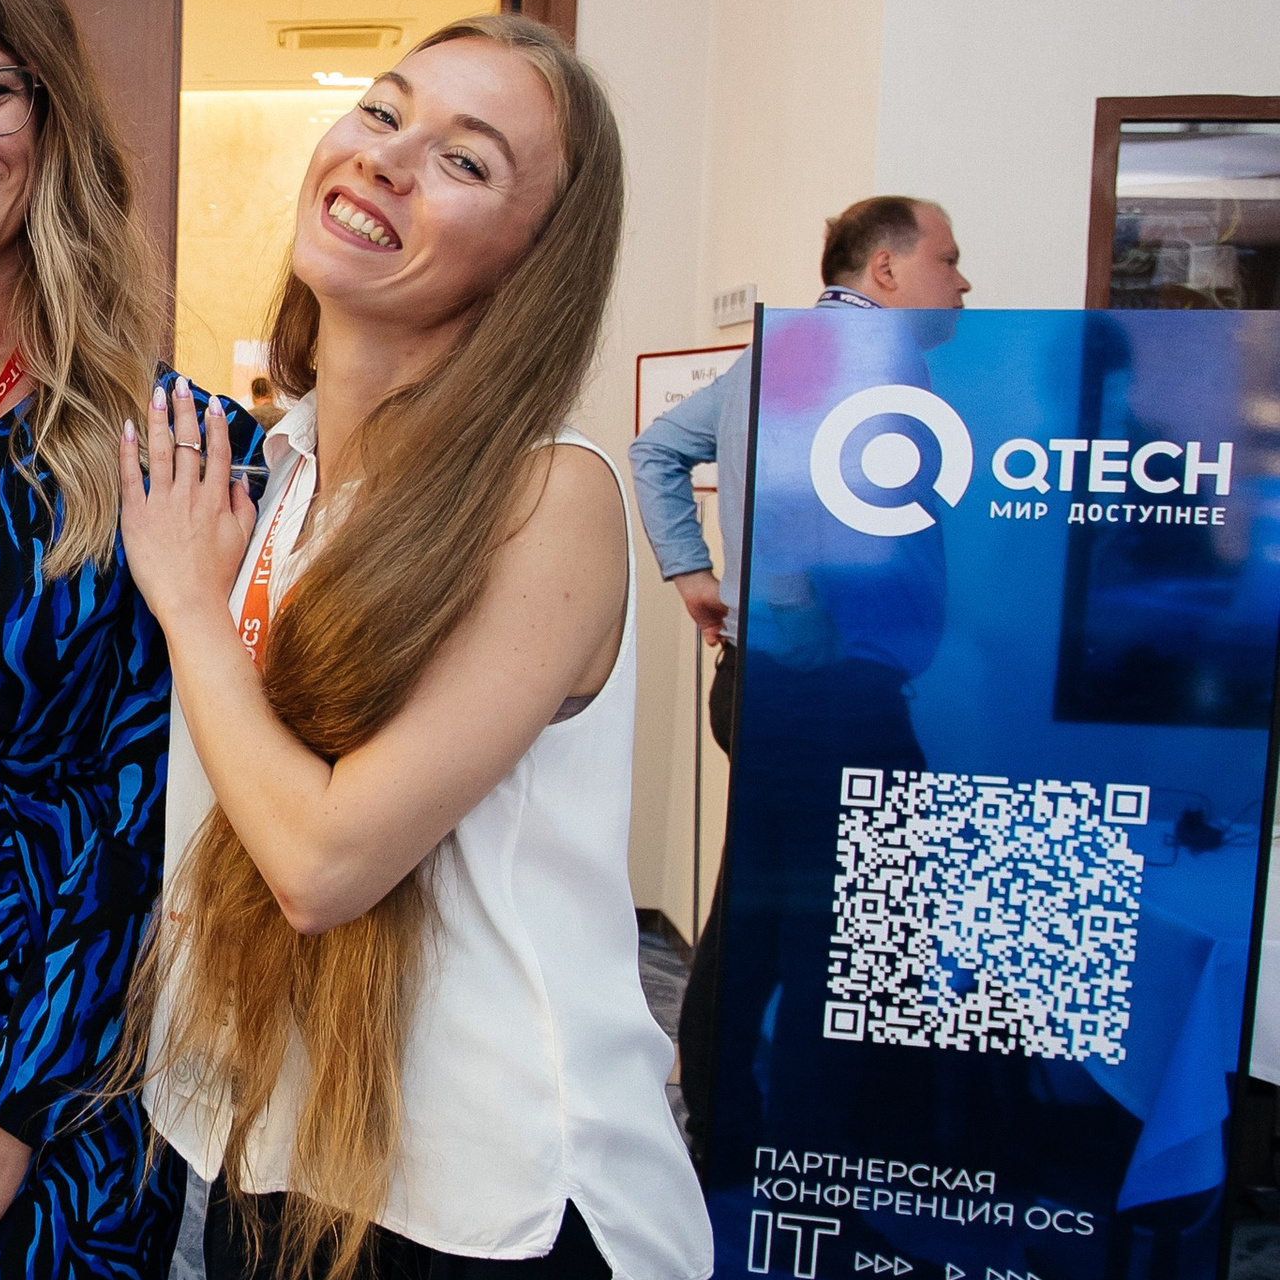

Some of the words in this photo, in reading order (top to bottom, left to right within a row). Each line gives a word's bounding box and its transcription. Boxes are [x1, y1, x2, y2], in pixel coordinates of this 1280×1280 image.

[991, 437, 1234, 496] QTECH
[989, 501, 1049, 520] МИР
[1067, 503, 1227, 525] ДОСТУПНЕЕ
[754, 1146, 996, 1195] ПАРТНЕРСКАЯ
[752, 1175, 1015, 1227] КОНФЕРЕНЦИЯ
[1024, 1206, 1095, 1236] OCS
[747, 1209, 841, 1280] IT
